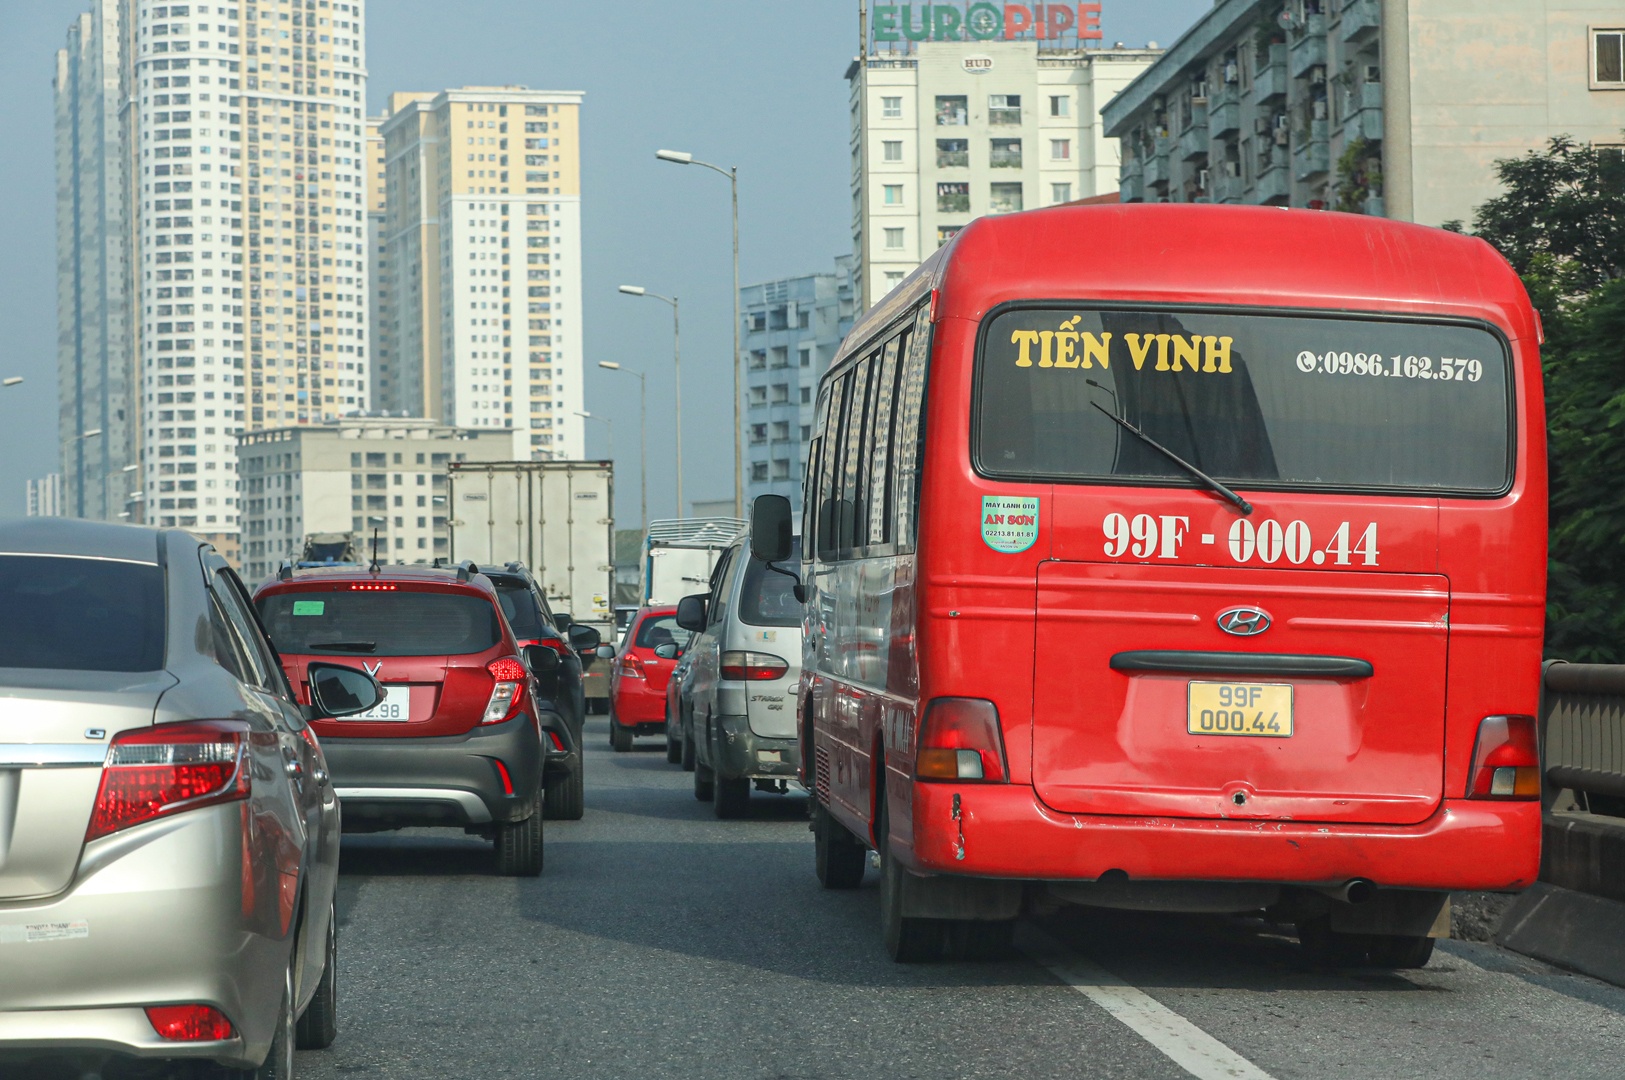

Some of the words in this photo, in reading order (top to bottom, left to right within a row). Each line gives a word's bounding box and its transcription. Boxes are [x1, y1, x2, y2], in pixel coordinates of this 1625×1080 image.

[874, 2, 1103, 41] EUROPIPE
[965, 58, 992, 68] HUD
[1011, 315, 1112, 370] TIẾN
[1124, 333, 1233, 373] VINH
[984, 514, 1005, 525] AN
[1102, 512, 1190, 559] 99F
[1228, 518, 1380, 566] 000.44
[1219, 686, 1263, 708] 99F
[1200, 709, 1281, 732] 000.44
[84, 728, 106, 739] G
